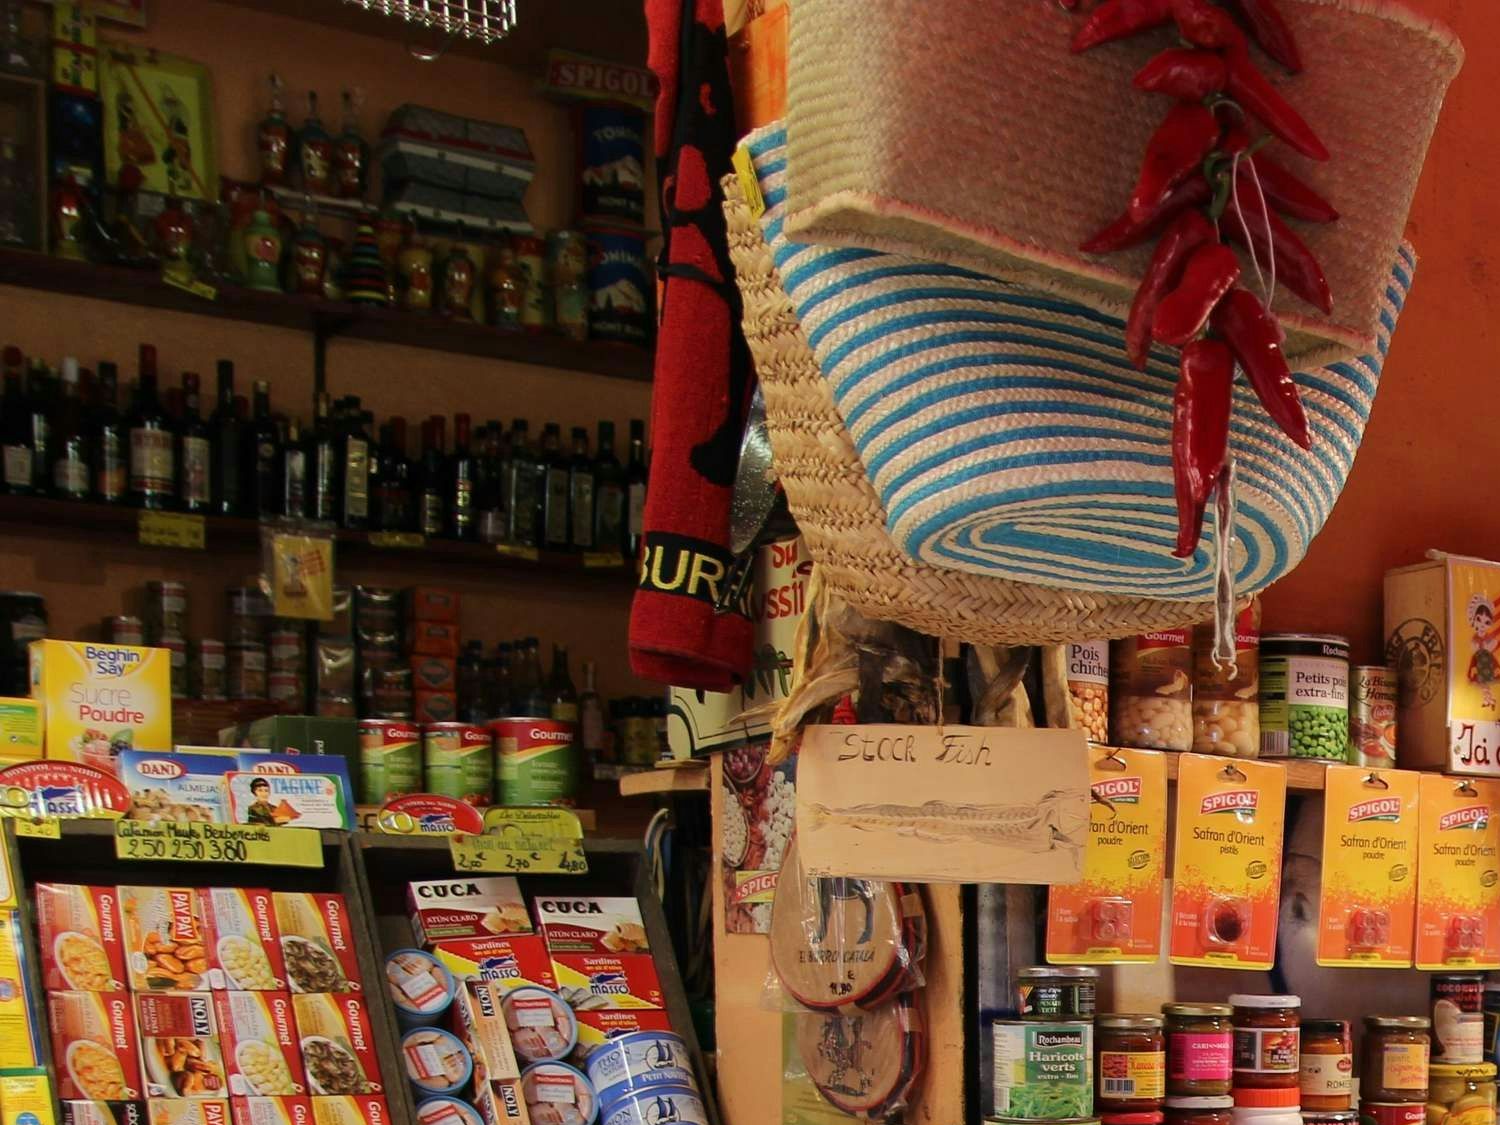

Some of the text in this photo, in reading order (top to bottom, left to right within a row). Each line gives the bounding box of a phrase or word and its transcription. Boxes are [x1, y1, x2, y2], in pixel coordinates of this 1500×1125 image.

[1144, 631, 1185, 645] Gourmet
[86, 646, 140, 663] Beghin
[1071, 643, 1100, 661] Pois
[97, 659, 126, 676] Say
[1295, 671, 1331, 686] Petits
[71, 682, 132, 706] Sucre
[79, 704, 145, 724] Poudre
[141, 763, 177, 777] DANI
[271, 777, 323, 796] TAGINE
[1091, 778, 1140, 798] PIGOL
[1201, 792, 1257, 815] SPIGOL
[1348, 799, 1400, 821] SPIGOL
[1440, 807, 1489, 829] SPIGOL
[1111, 820, 1149, 836] d'Orient
[1193, 827, 1265, 847] Safran d'Orient
[1340, 834, 1407, 852] Safran d'Orient
[1433, 842, 1497, 859] Safran d'Orient
[417, 882, 482, 899] CUCA
[541, 899, 604, 914] CUCA
[101, 893, 116, 943] Gourmet
[255, 894, 274, 943] Gourmet
[326, 899, 346, 951] Gourmet
[450, 913, 479, 924] CLARO
[568, 929, 599, 939] CLARO
[471, 940, 511, 951] Sardines
[583, 957, 622, 967] Sardines
[477, 986, 495, 1017] NOLY
[112, 999, 129, 1050] Gourmet
[191, 998, 209, 1037] NOLY
[273, 998, 291, 1046] Gourmet
[347, 999, 367, 1052] Gourmet
[597, 1012, 637, 1022] Sardines
[1029, 1051, 1085, 1062] Haricots
[1042, 1062, 1076, 1073] verts
[502, 1086, 520, 1117] NOLY
